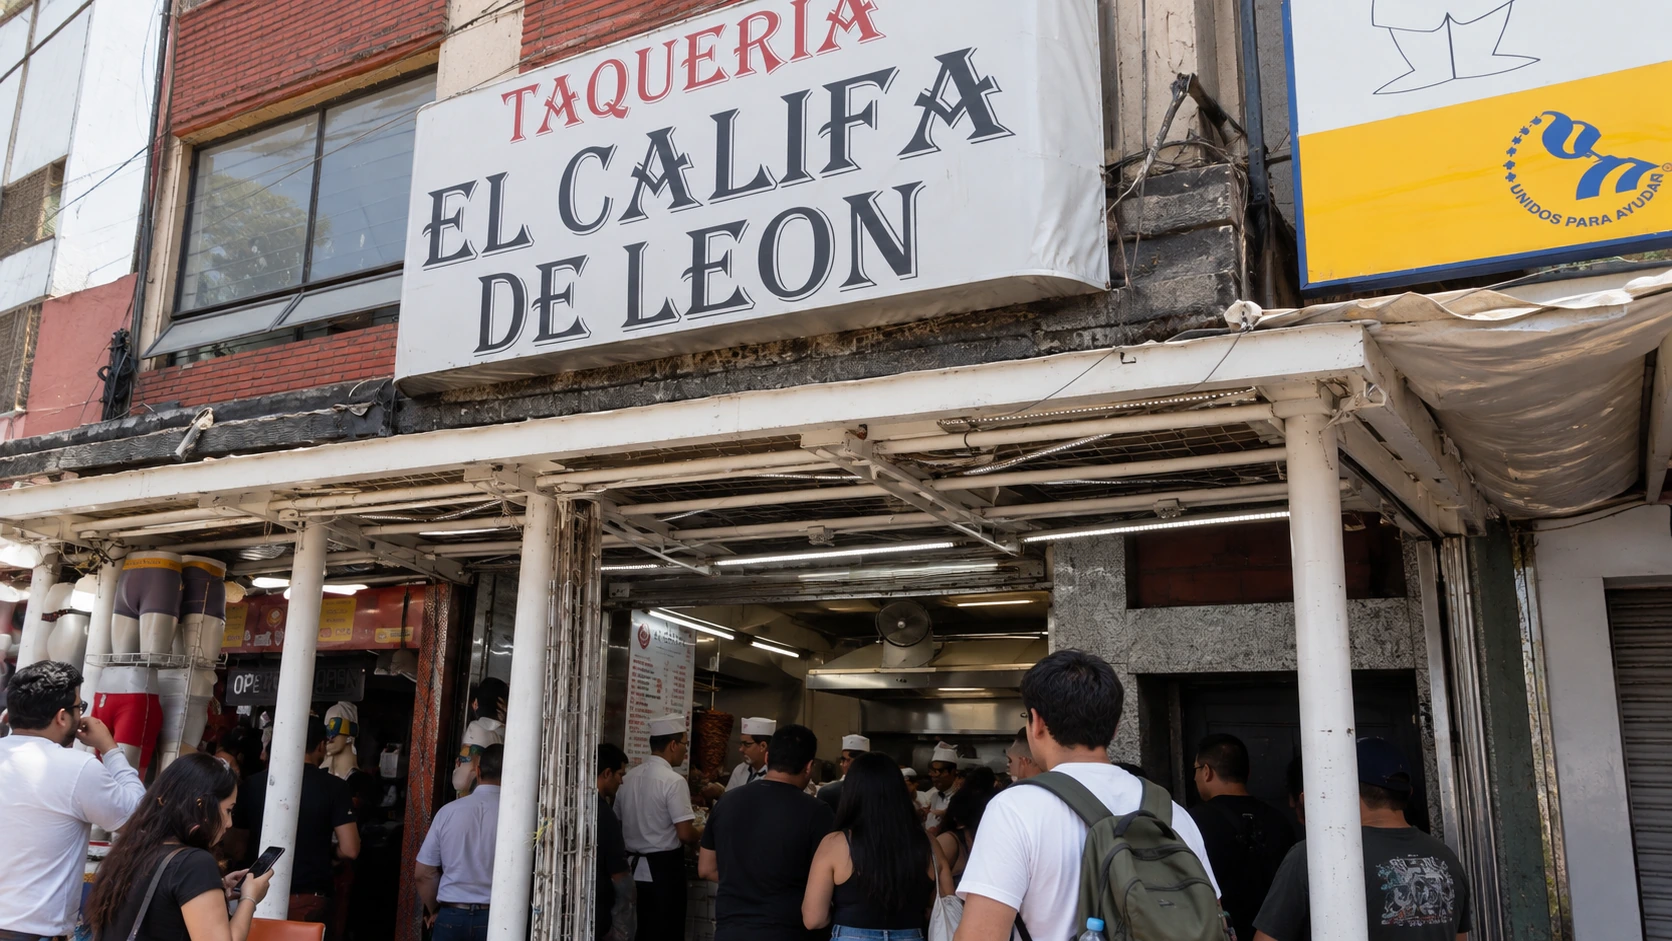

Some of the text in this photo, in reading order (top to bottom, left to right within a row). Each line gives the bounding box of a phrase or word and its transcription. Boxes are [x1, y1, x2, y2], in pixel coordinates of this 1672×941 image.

[501, 0, 887, 144] TAQUERIA
[422, 47, 1014, 271] EL CALIFA
[1510, 173, 1664, 227] UNIDOS PARA AYUDAR
[474, 180, 926, 358] DE LEON
